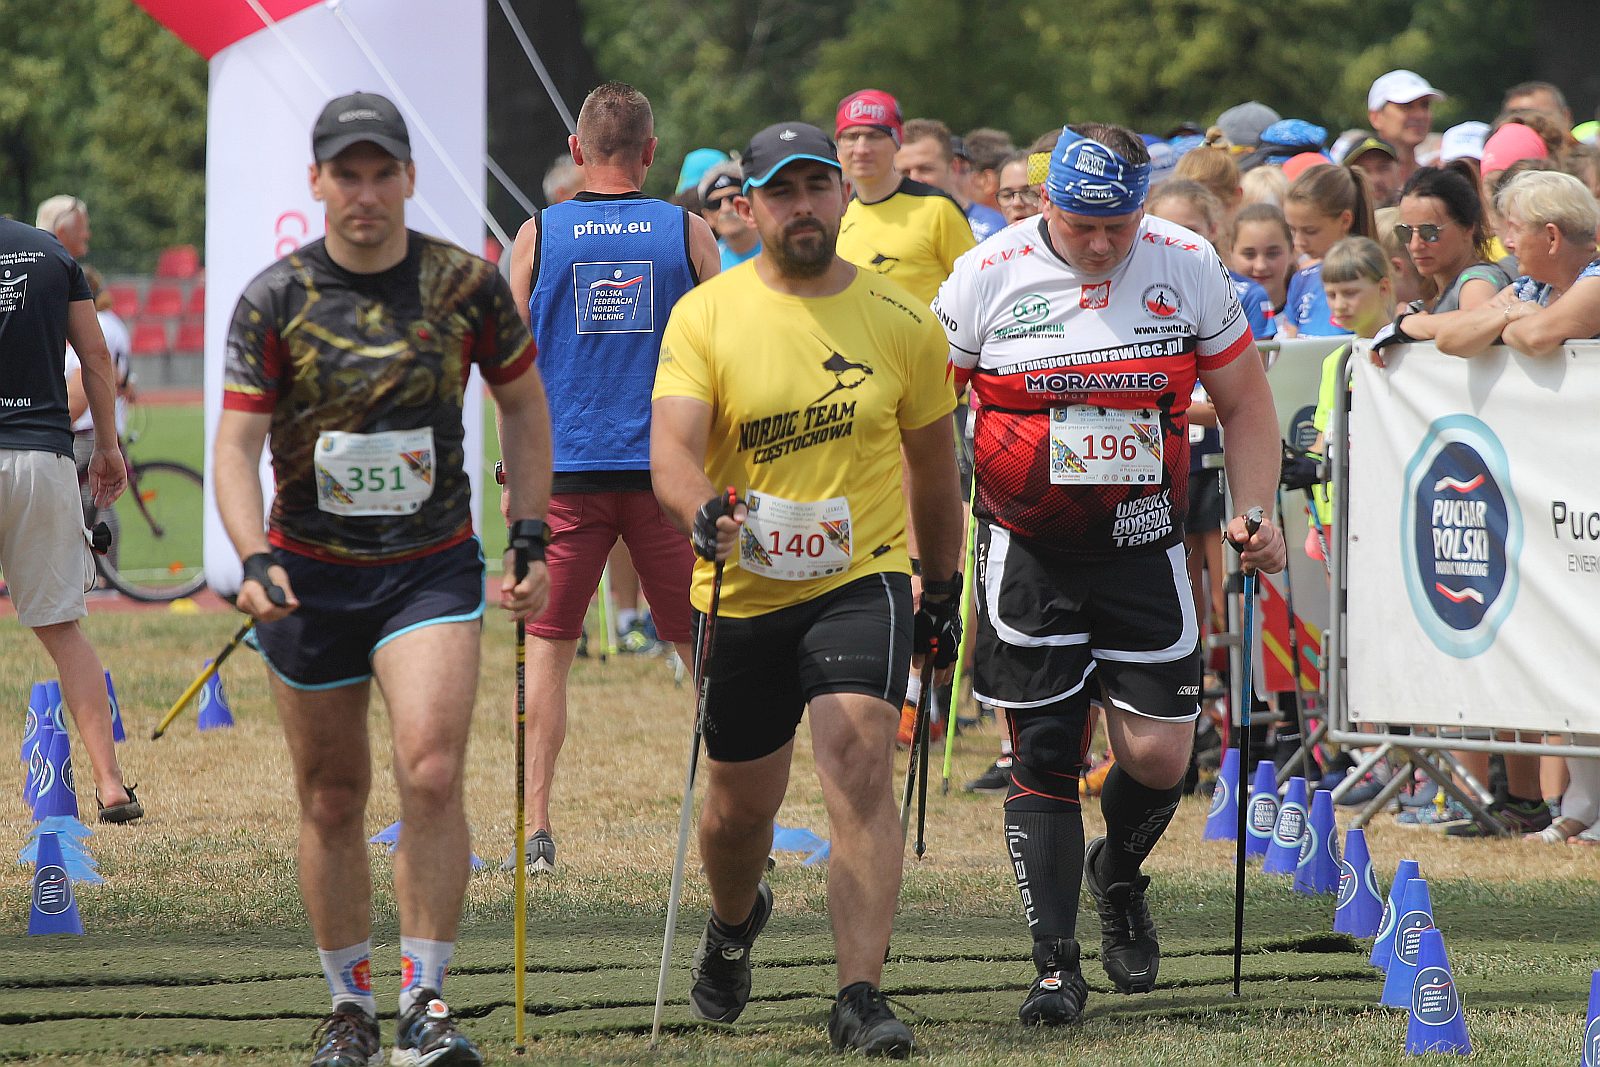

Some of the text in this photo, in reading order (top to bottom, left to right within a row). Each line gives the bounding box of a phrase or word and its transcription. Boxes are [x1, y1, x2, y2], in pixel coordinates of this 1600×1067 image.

[850, 99, 886, 120] Buff
[573, 220, 651, 239] pfnw.eu
[594, 297, 633, 305] FEDERACJA
[595, 290, 623, 298] POLSKA
[591, 312, 625, 321] WALKING
[592, 305, 620, 313] NORDIC
[998, 337, 1183, 376] www.transportmorawiec.pl
[1024, 372, 1169, 394] MORAWIEC
[737, 400, 857, 453] NORDIC TEAM
[753, 421, 853, 464] CZĘSTOCHOWA
[1082, 434, 1137, 461] 196
[346, 466, 406, 492] 351
[1116, 488, 1171, 518] WESOŁY
[1432, 499, 1488, 528] PUCHAR
[1112, 505, 1172, 536] BORSUK
[1551, 501, 1600, 541] Puc
[768, 530, 825, 558] 140
[1112, 526, 1173, 547] TEAM
[1432, 528, 1489, 562] POLSKI
[1254, 803, 1273, 811] 2019
[1281, 812, 1300, 821] 2019
